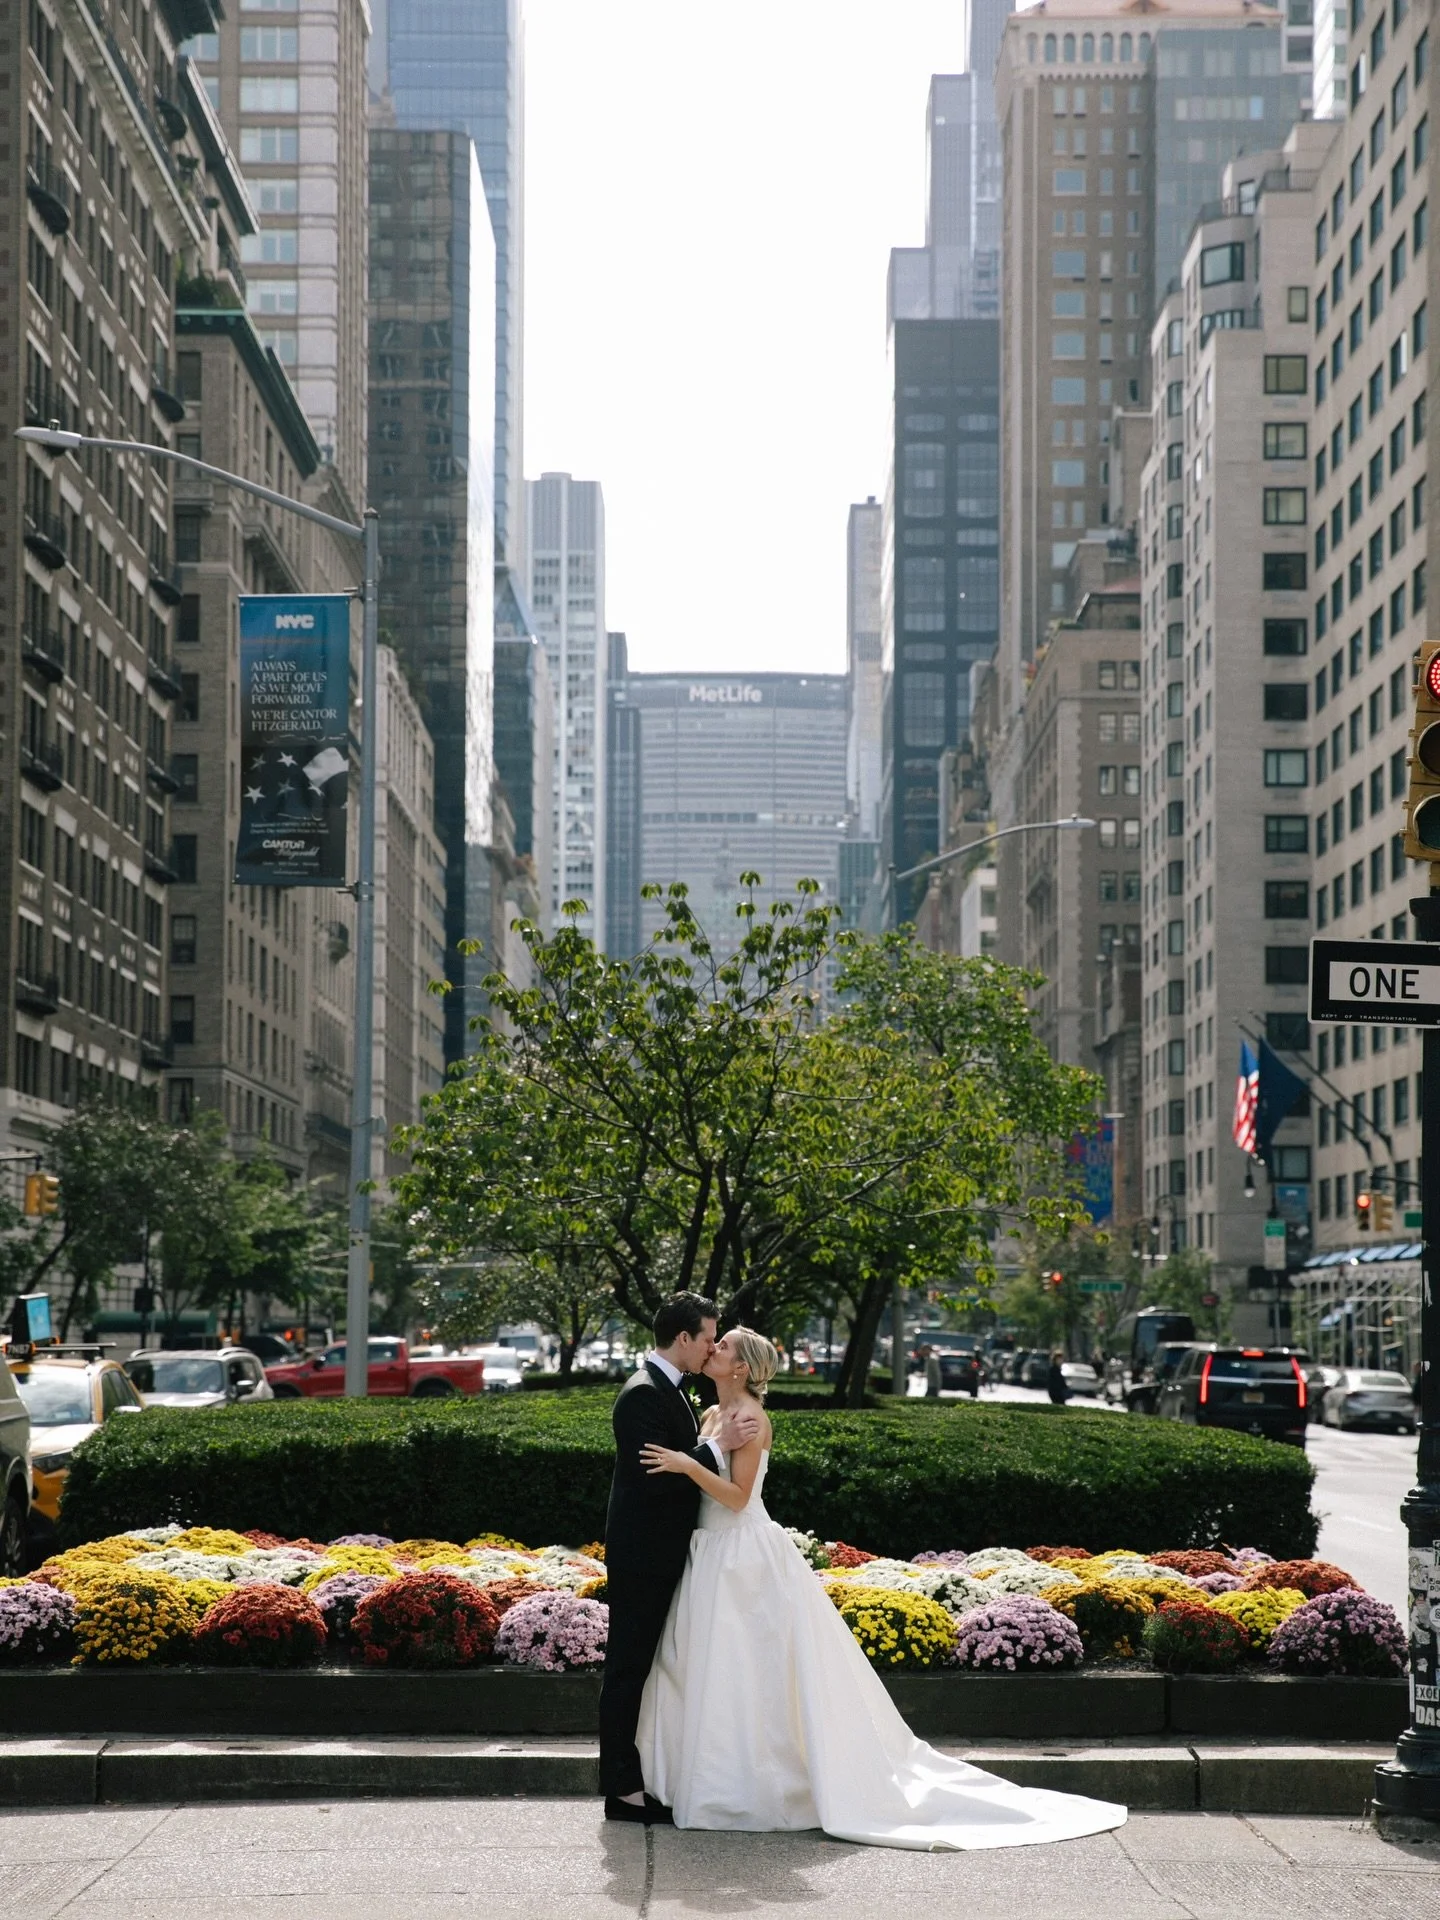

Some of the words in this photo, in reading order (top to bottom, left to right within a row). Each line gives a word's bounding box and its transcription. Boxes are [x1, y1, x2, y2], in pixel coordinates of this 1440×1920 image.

[275, 614, 315, 629] NYC
[251, 661, 297, 672] ALWAYS
[251, 672, 260, 682] A
[262, 672, 293, 682] PART
[294, 672, 310, 681] OF
[312, 671, 328, 681] US
[251, 683, 266, 694] AS
[268, 683, 289, 693] WE
[290, 682, 324, 693] MOVE
[689, 684, 763, 702] MetLife
[251, 694, 313, 705] FORWARD.
[251, 709, 289, 720] WE'RE
[290, 708, 337, 720] CANTOR
[251, 720, 323, 731] FITZGERALD.
[262, 839, 305, 849] CANTOR
[1349, 966, 1420, 1000] ONE
